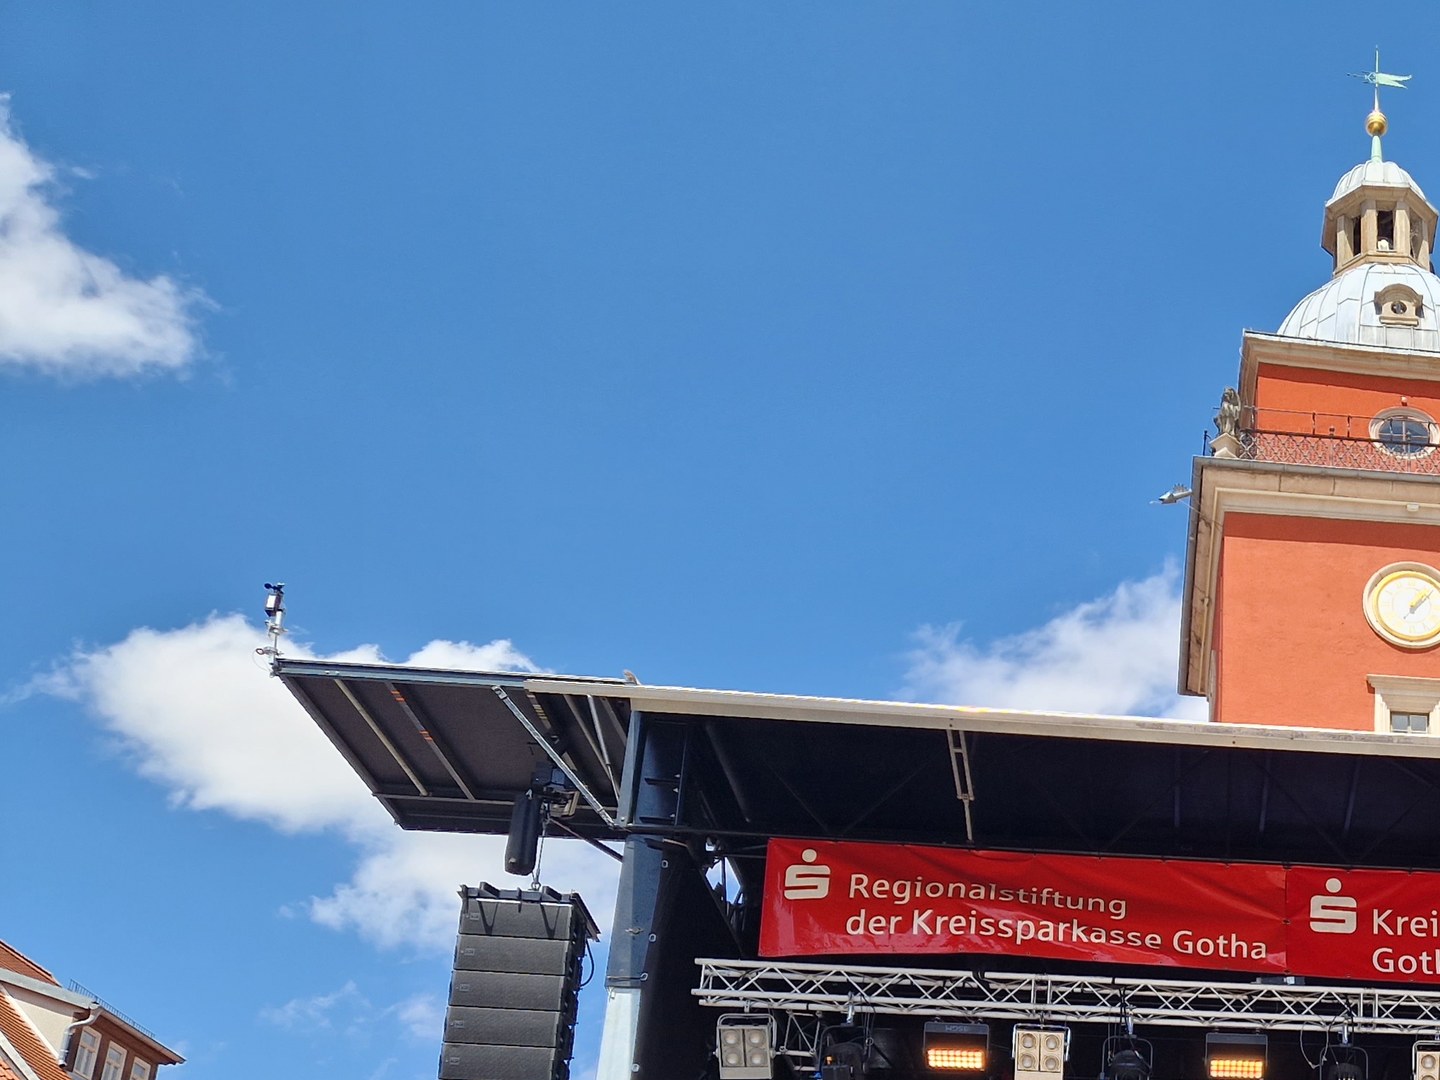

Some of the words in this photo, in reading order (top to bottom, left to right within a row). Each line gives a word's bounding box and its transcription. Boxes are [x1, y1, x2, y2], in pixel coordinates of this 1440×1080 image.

[848, 873, 1127, 920] Regionalstiftung
[846, 908, 903, 936] der
[912, 909, 1162, 949] Kreissparkasse
[1172, 930, 1267, 960] Gotha
